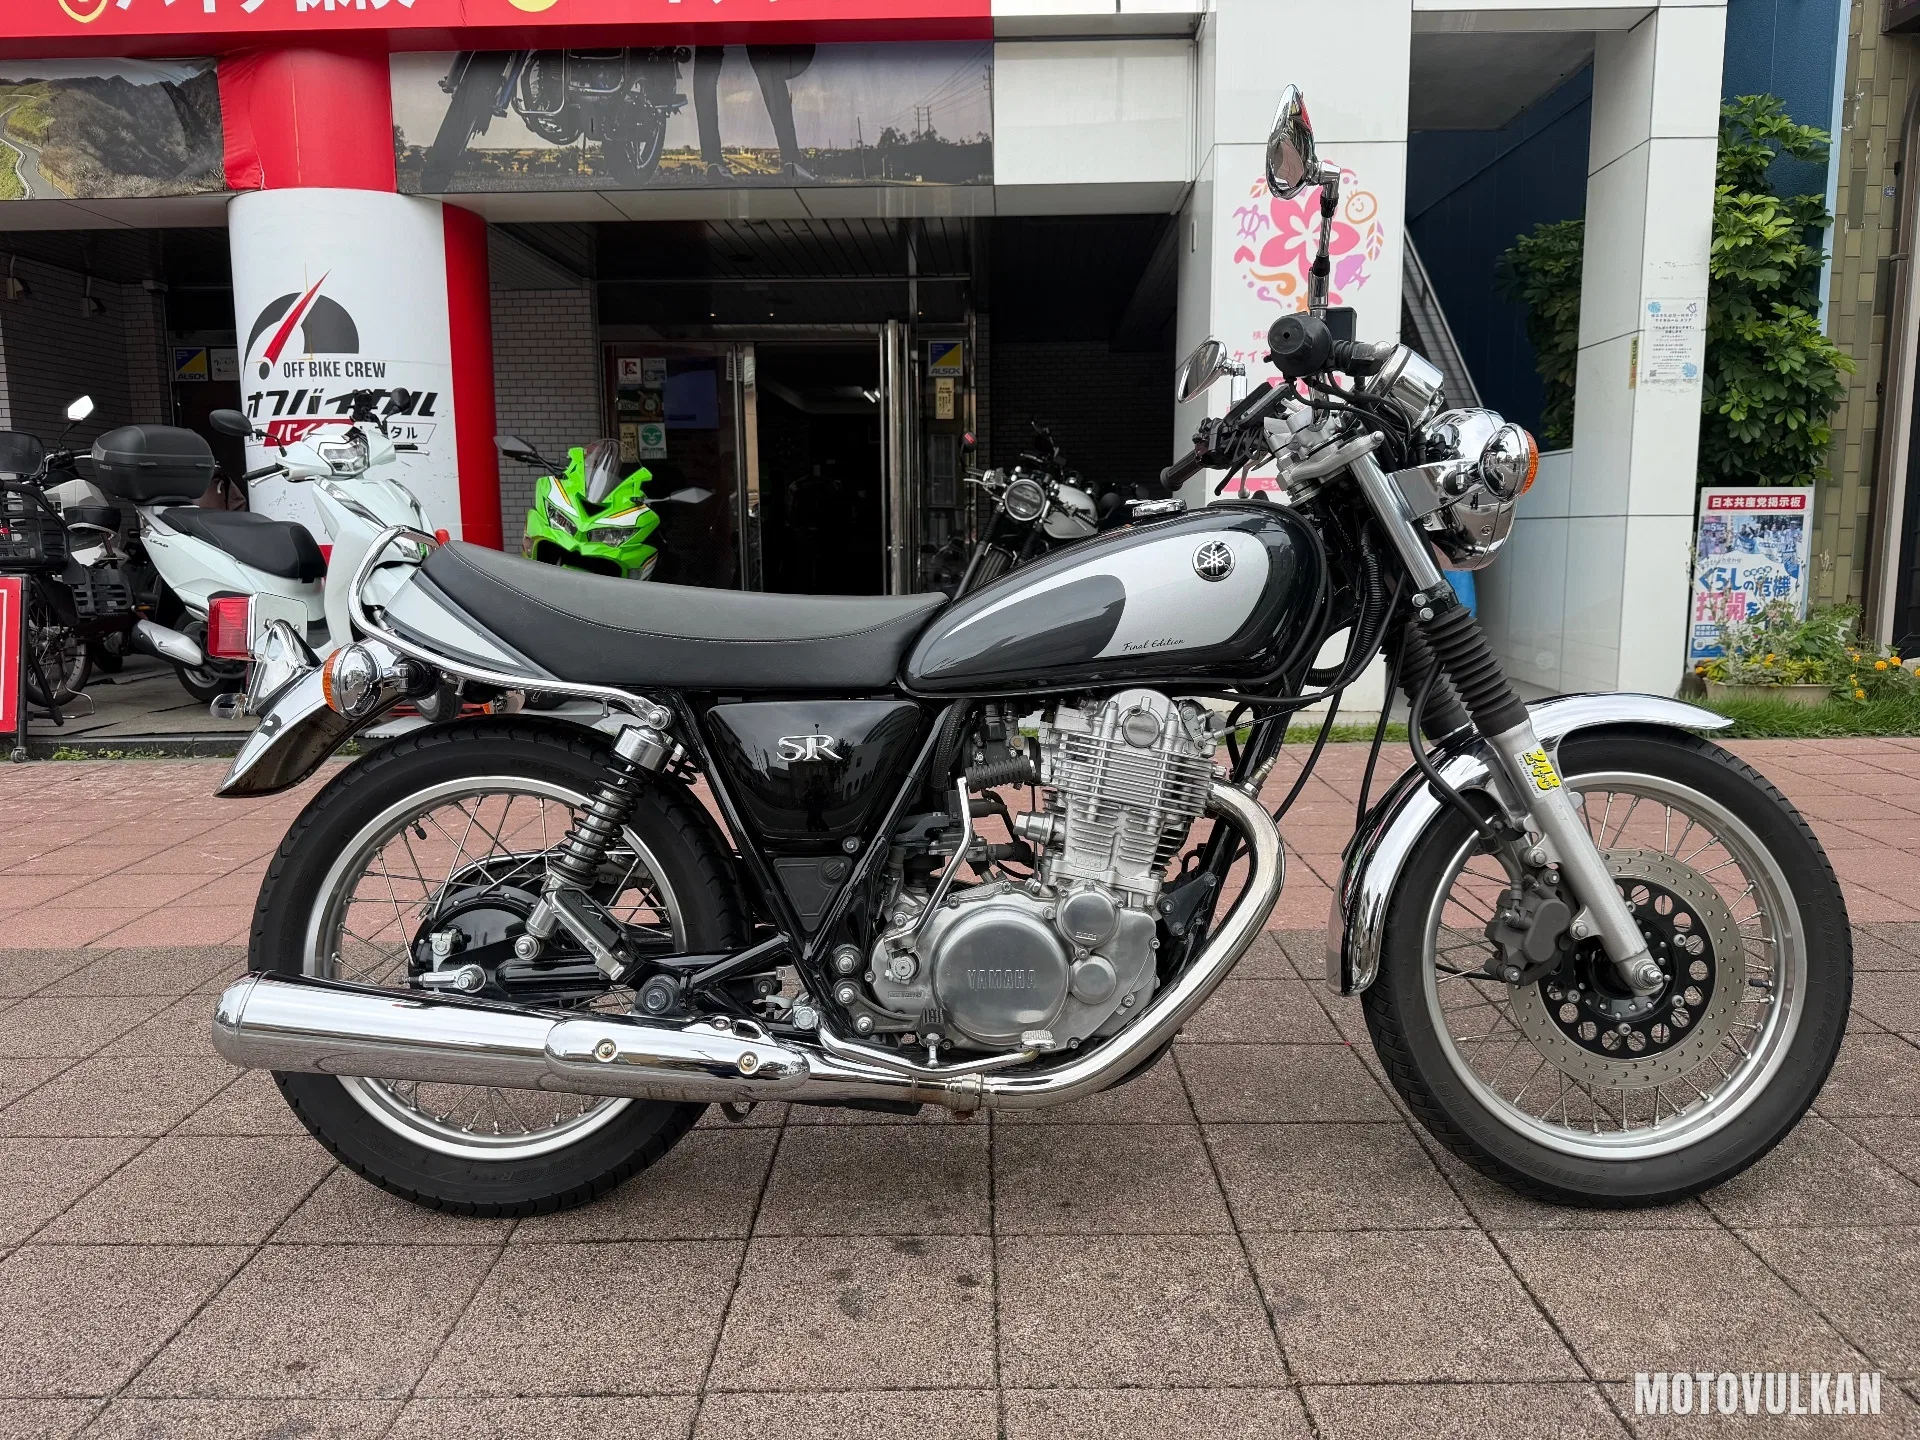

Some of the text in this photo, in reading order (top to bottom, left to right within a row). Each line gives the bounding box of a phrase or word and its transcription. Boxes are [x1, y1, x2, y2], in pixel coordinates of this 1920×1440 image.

[283, 361, 386, 379] OFF BIKE CREW
[931, 367, 961, 375] ALSOK
[1711, 497, 1801, 508] 日本共産党掲示板
[1122, 637, 1186, 652] Final Edition
[776, 734, 843, 762] SR
[1522, 748, 1560, 790] 248
[967, 968, 1036, 990] YAMAHA
